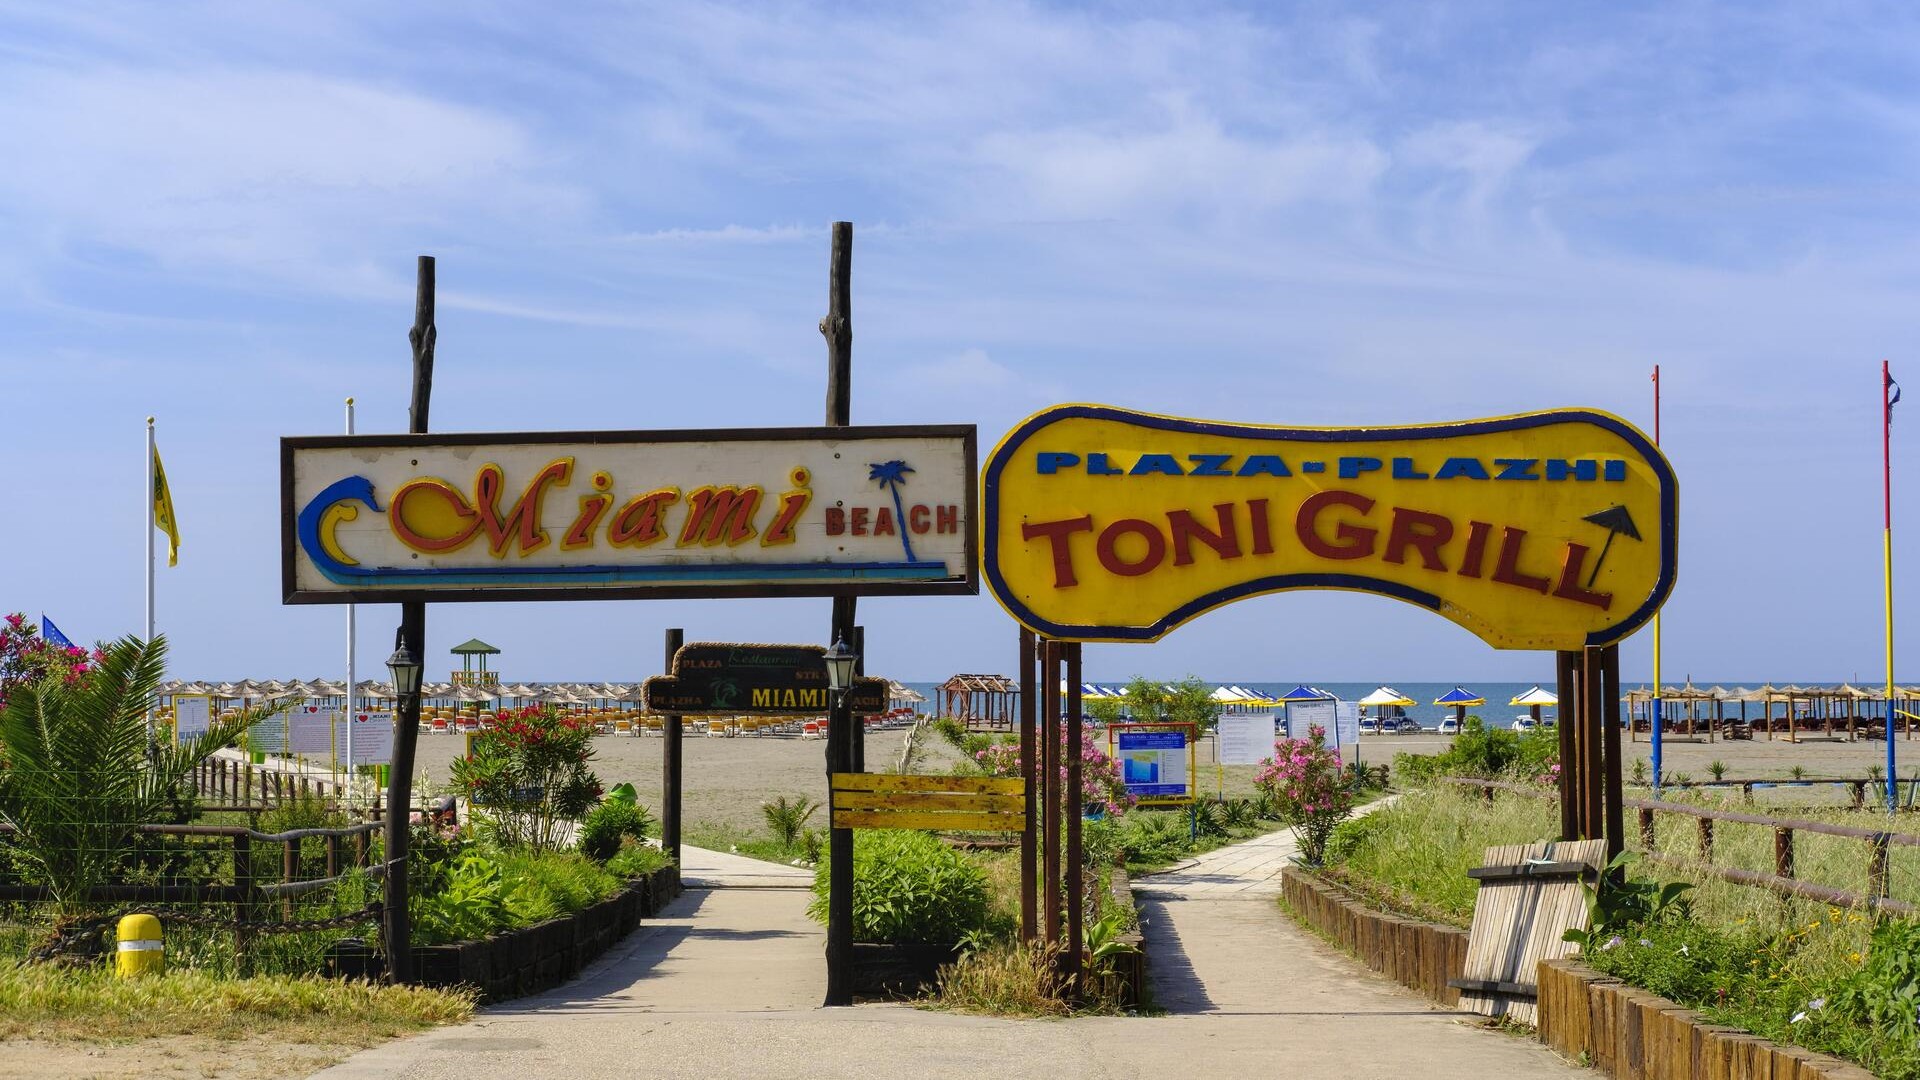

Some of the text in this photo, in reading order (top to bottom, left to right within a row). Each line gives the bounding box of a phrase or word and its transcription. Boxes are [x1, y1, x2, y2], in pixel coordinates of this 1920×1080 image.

[1036, 451, 1626, 481] PLAZA-PLAZHI
[388, 455, 958, 561] Miami BEACH
[1021, 490, 1613, 611] TONI GRILL
[682, 658, 722, 668] PLAZA
[752, 688, 829, 707] MIAMI
